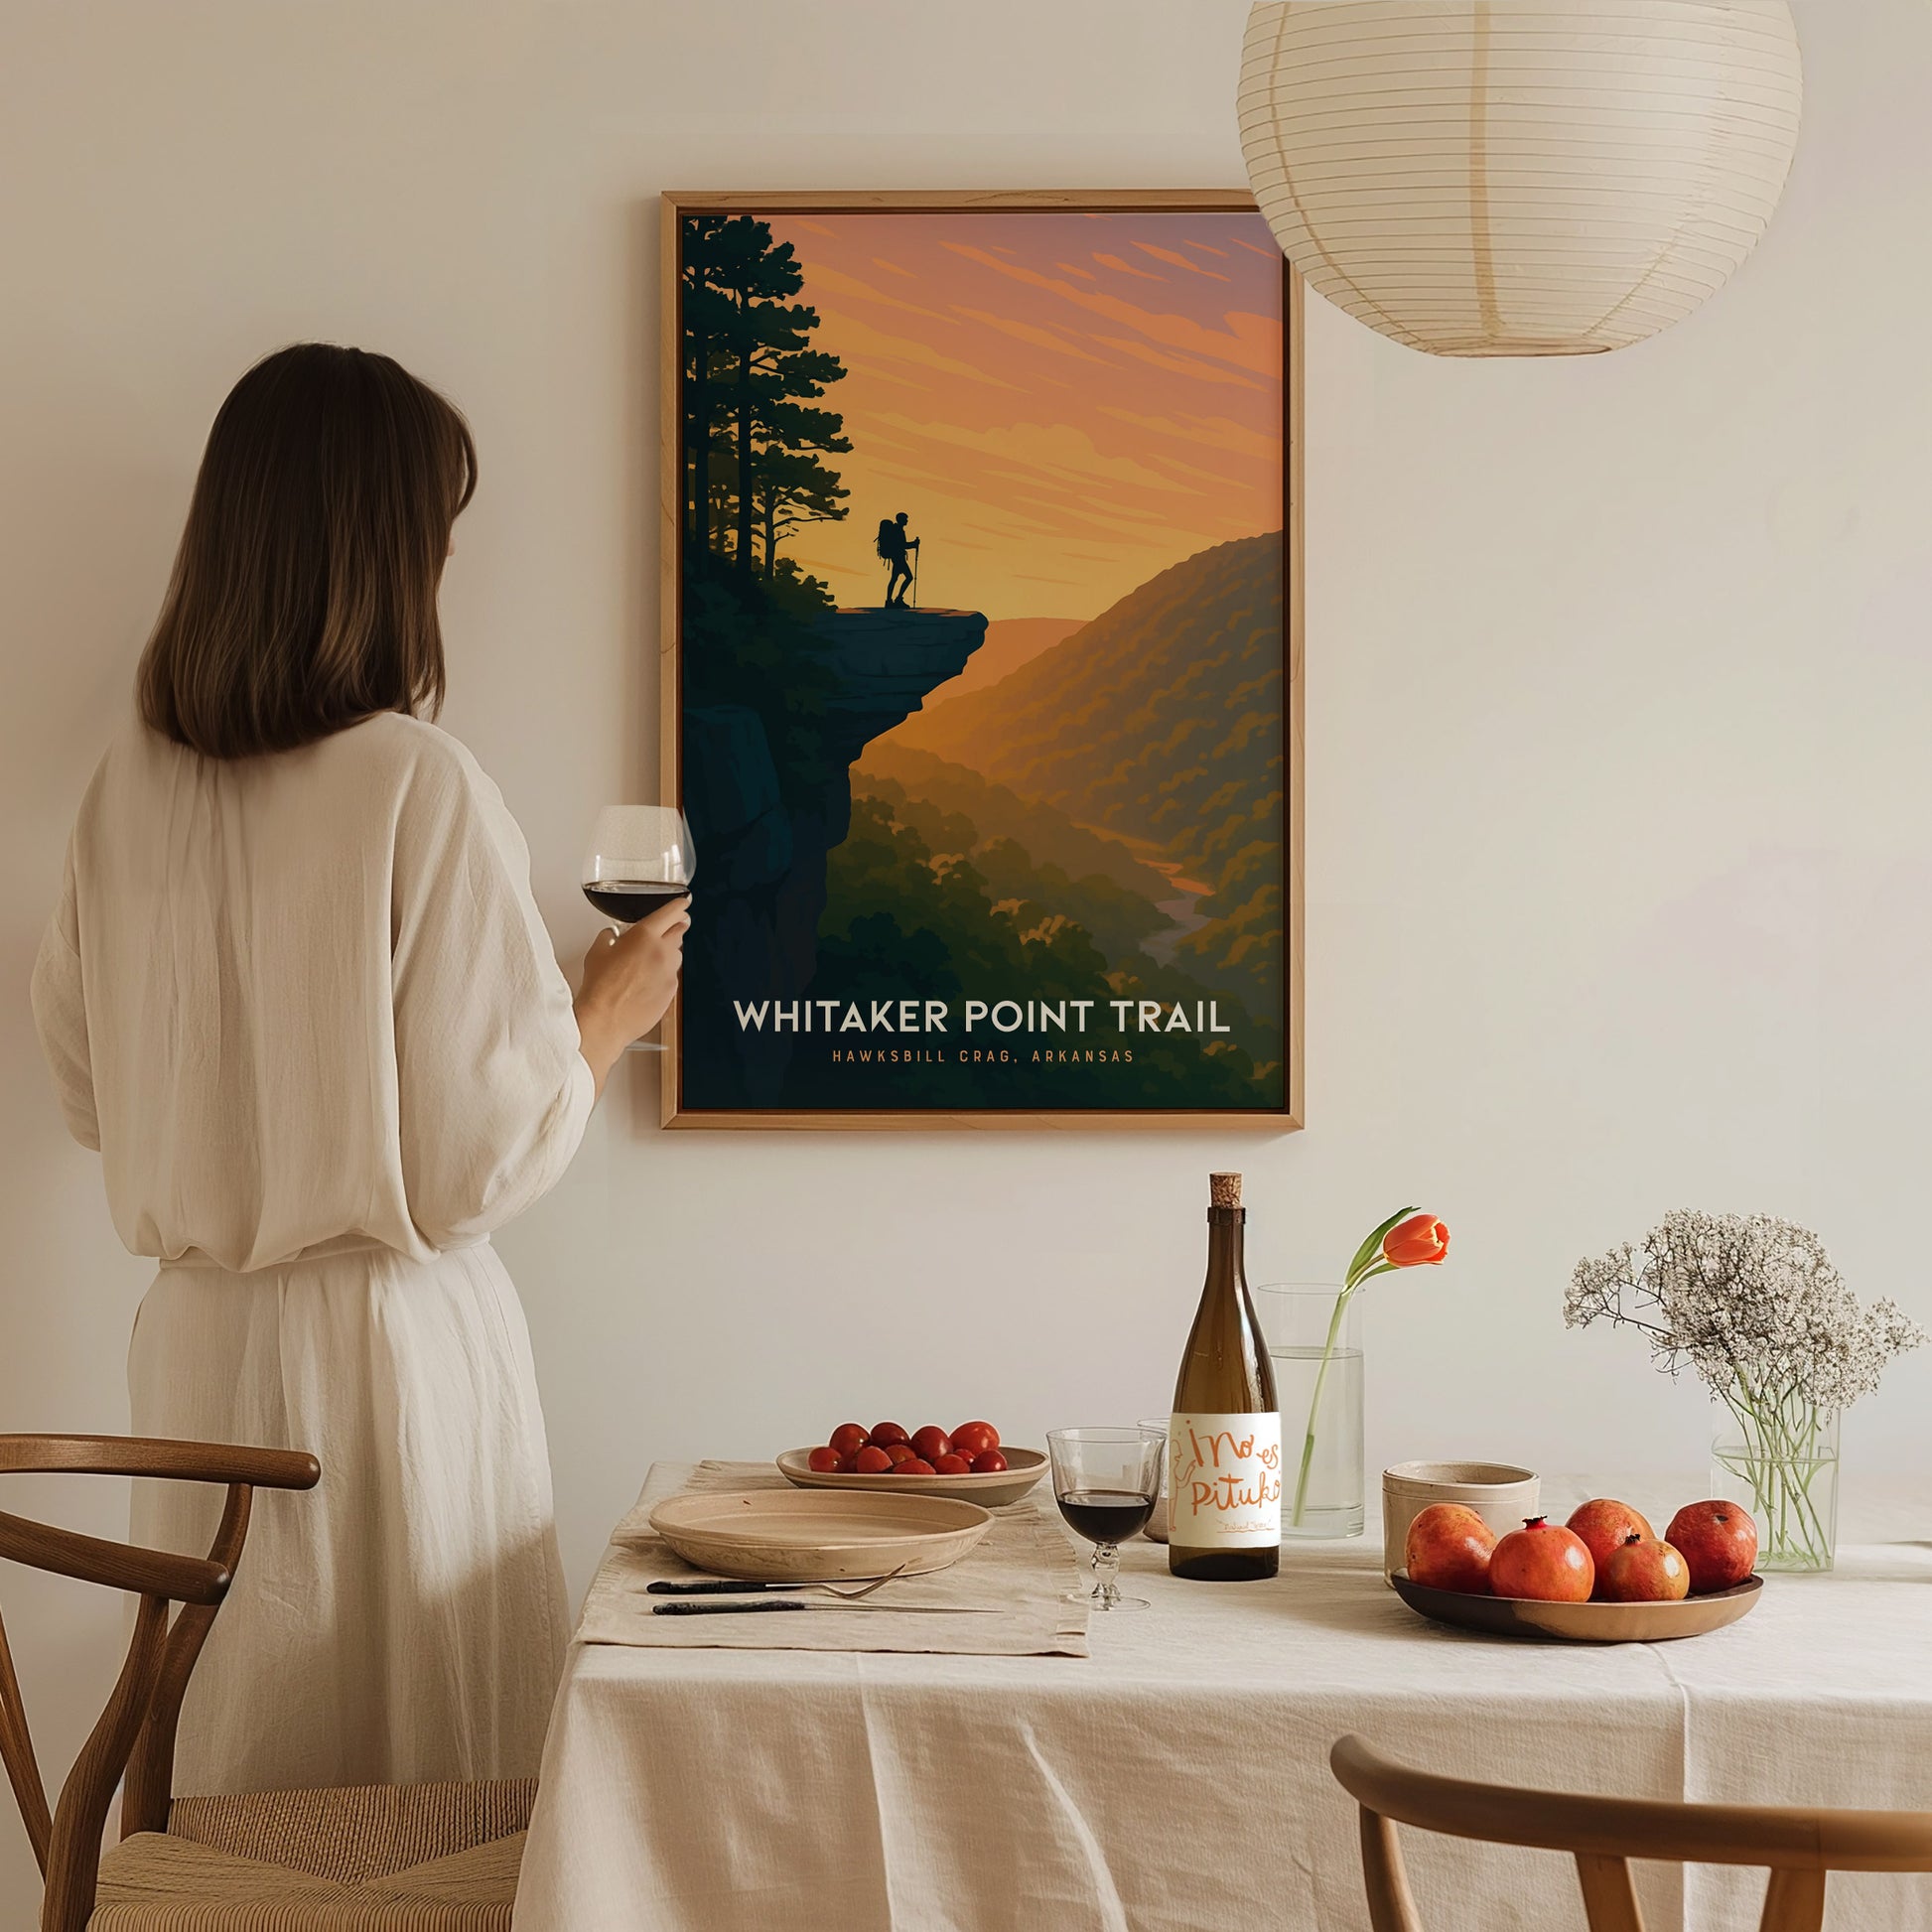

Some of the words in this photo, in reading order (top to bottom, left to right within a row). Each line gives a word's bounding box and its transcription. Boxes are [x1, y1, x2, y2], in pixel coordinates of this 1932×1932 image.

[733, 1000, 948, 1033] WHITAKER
[964, 1000, 1094, 1033] POINT
[1110, 1000, 1231, 1033] TRAIL
[832, 1049, 947, 1063] HAWKSBILL
[959, 1049, 1019, 1064] CRAG,
[1032, 1049, 1135, 1063] ARKANSAS
